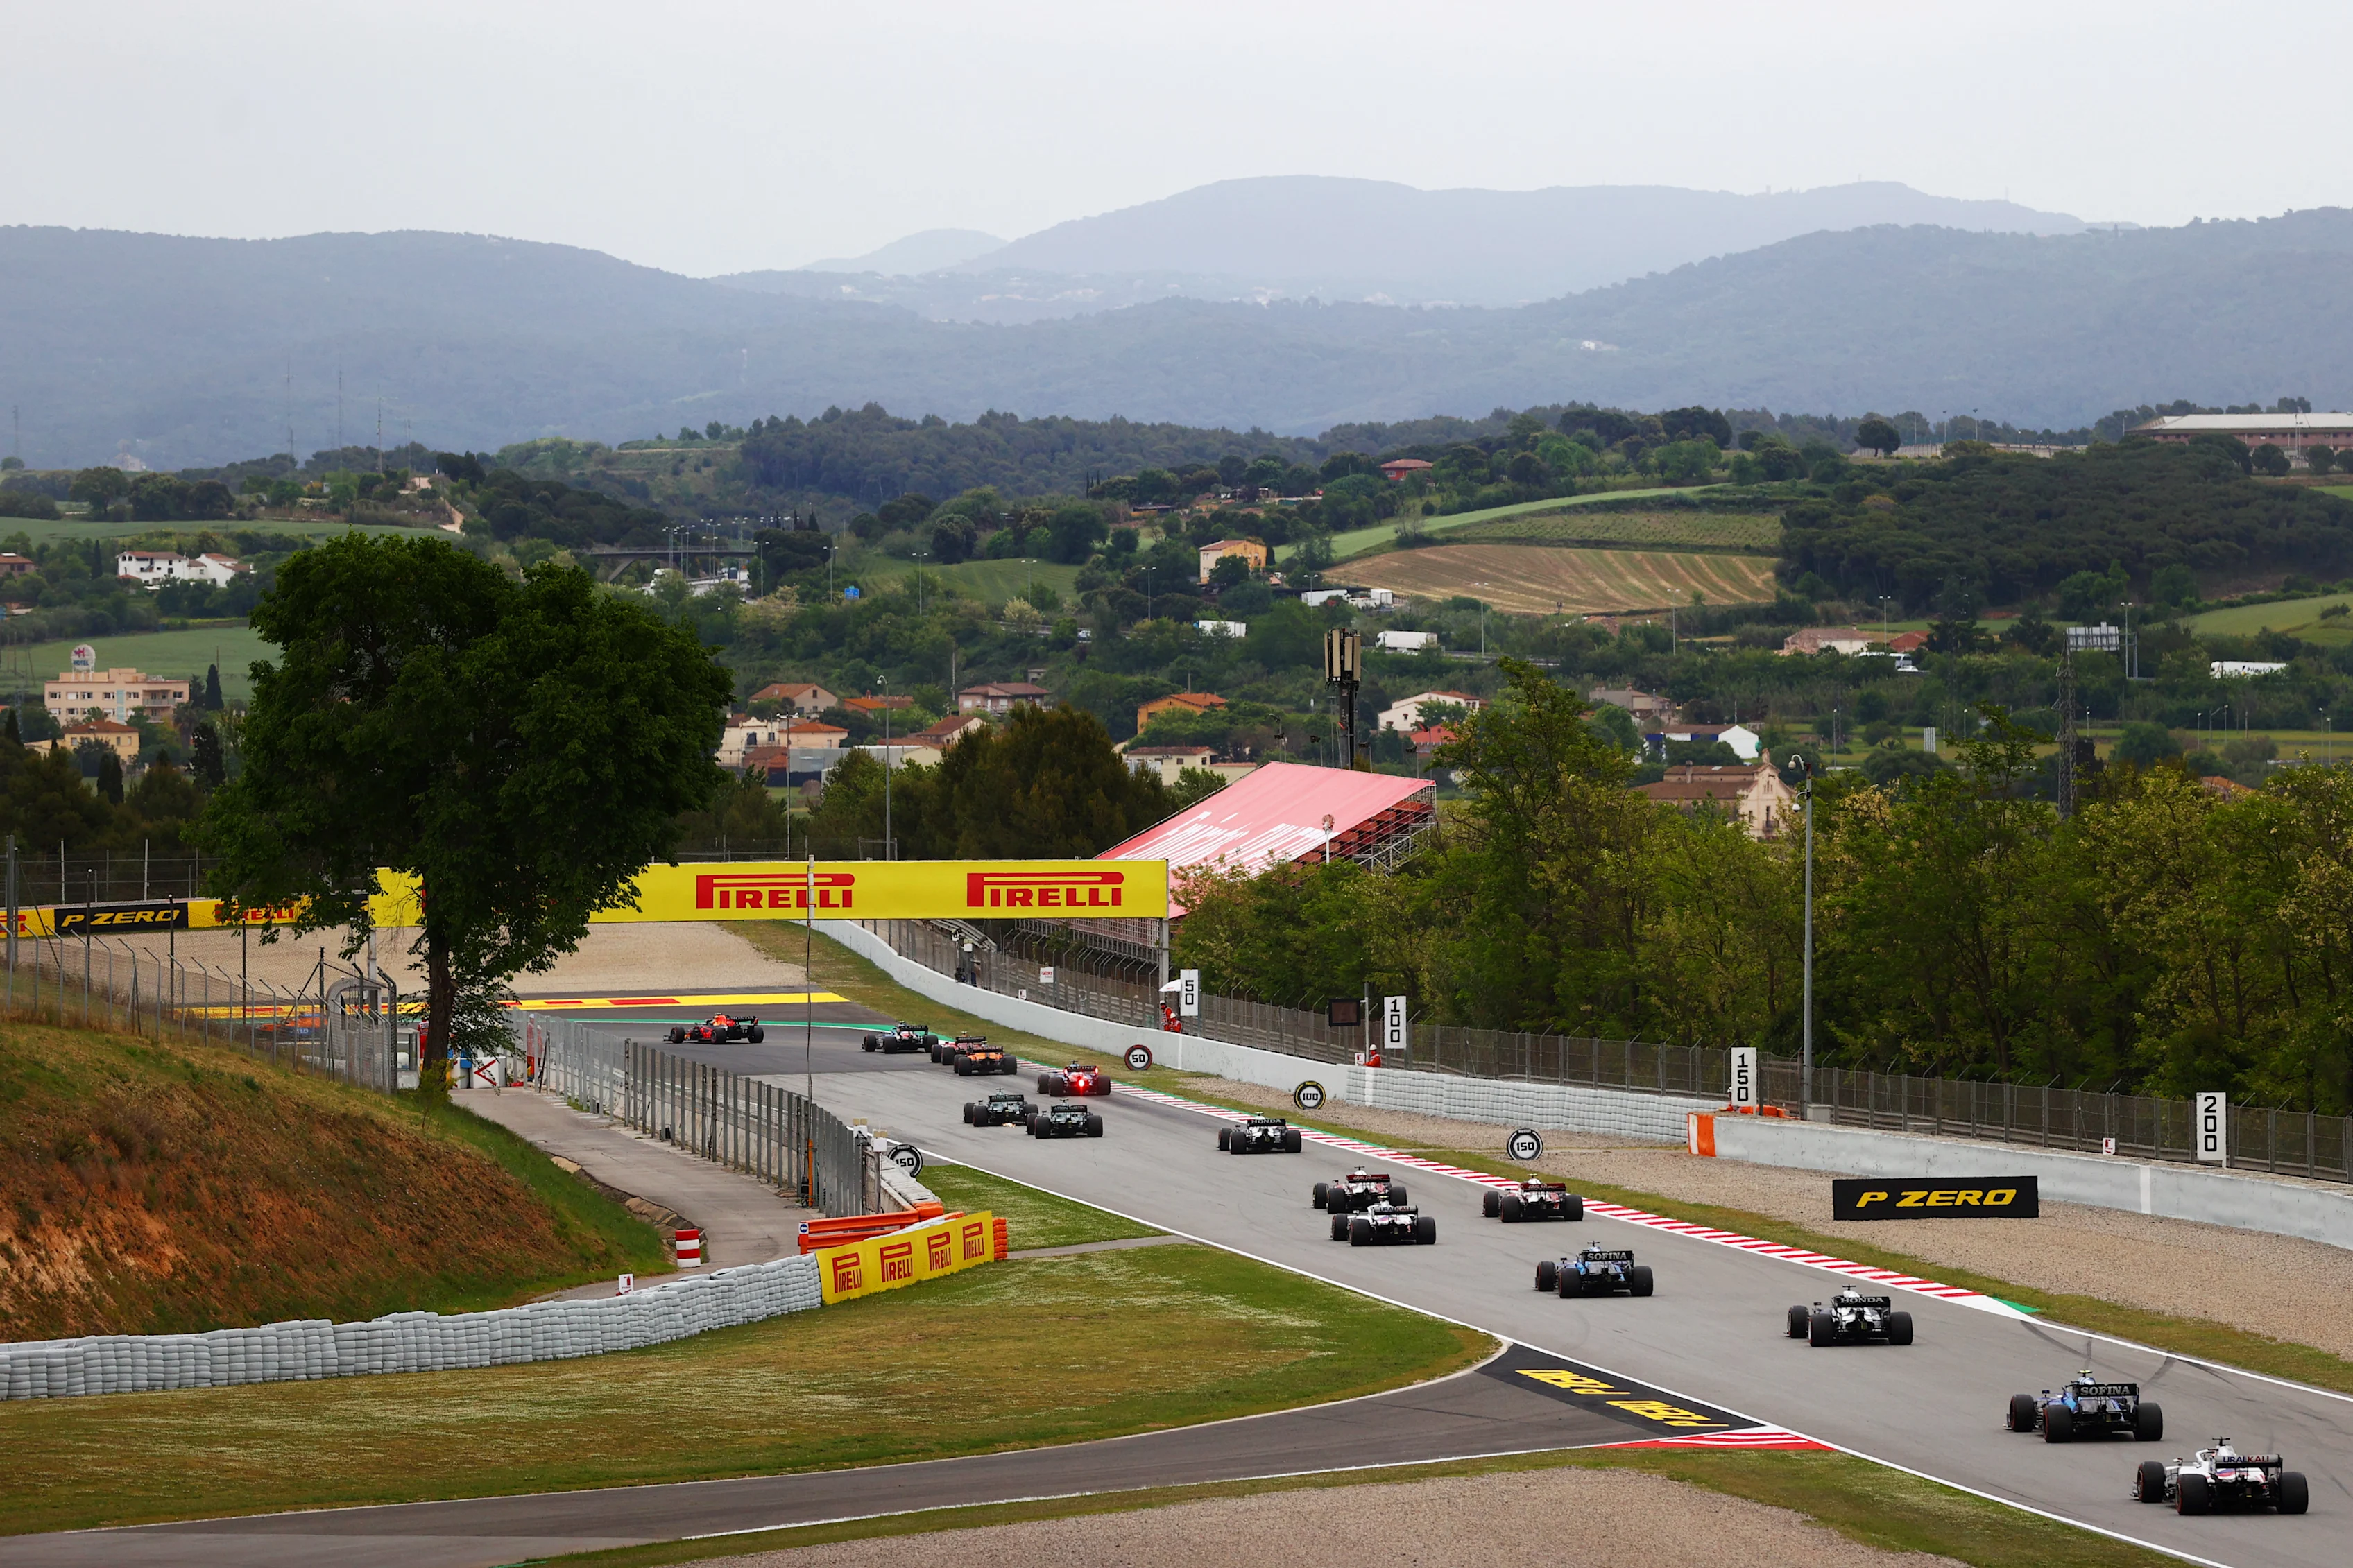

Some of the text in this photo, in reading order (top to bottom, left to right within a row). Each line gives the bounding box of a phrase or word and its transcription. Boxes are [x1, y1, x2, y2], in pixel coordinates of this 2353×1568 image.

[696, 873, 855, 909] PIRELLI
[967, 872, 1124, 907] PIRELLI
[61, 910, 180, 927] P ZERO
[1185, 979, 1194, 1005] 50
[1390, 999, 1400, 1042] 100
[1132, 1054, 1145, 1062] 50
[1738, 1053, 1748, 1101] 150
[2204, 1096, 2217, 1152] 200
[896, 1157, 914, 1167] 150
[1516, 1142, 1534, 1151] 150
[1856, 1189, 2017, 1207] P ZERO
[927, 1232, 952, 1271] PIRELLI
[963, 1222, 984, 1260] PIRELLI
[1587, 1252, 1627, 1261] SOFINA
[832, 1252, 862, 1293] PIRELLI
[880, 1242, 913, 1282] PIRELLI
[2081, 1386, 2130, 1395] SOFINA
